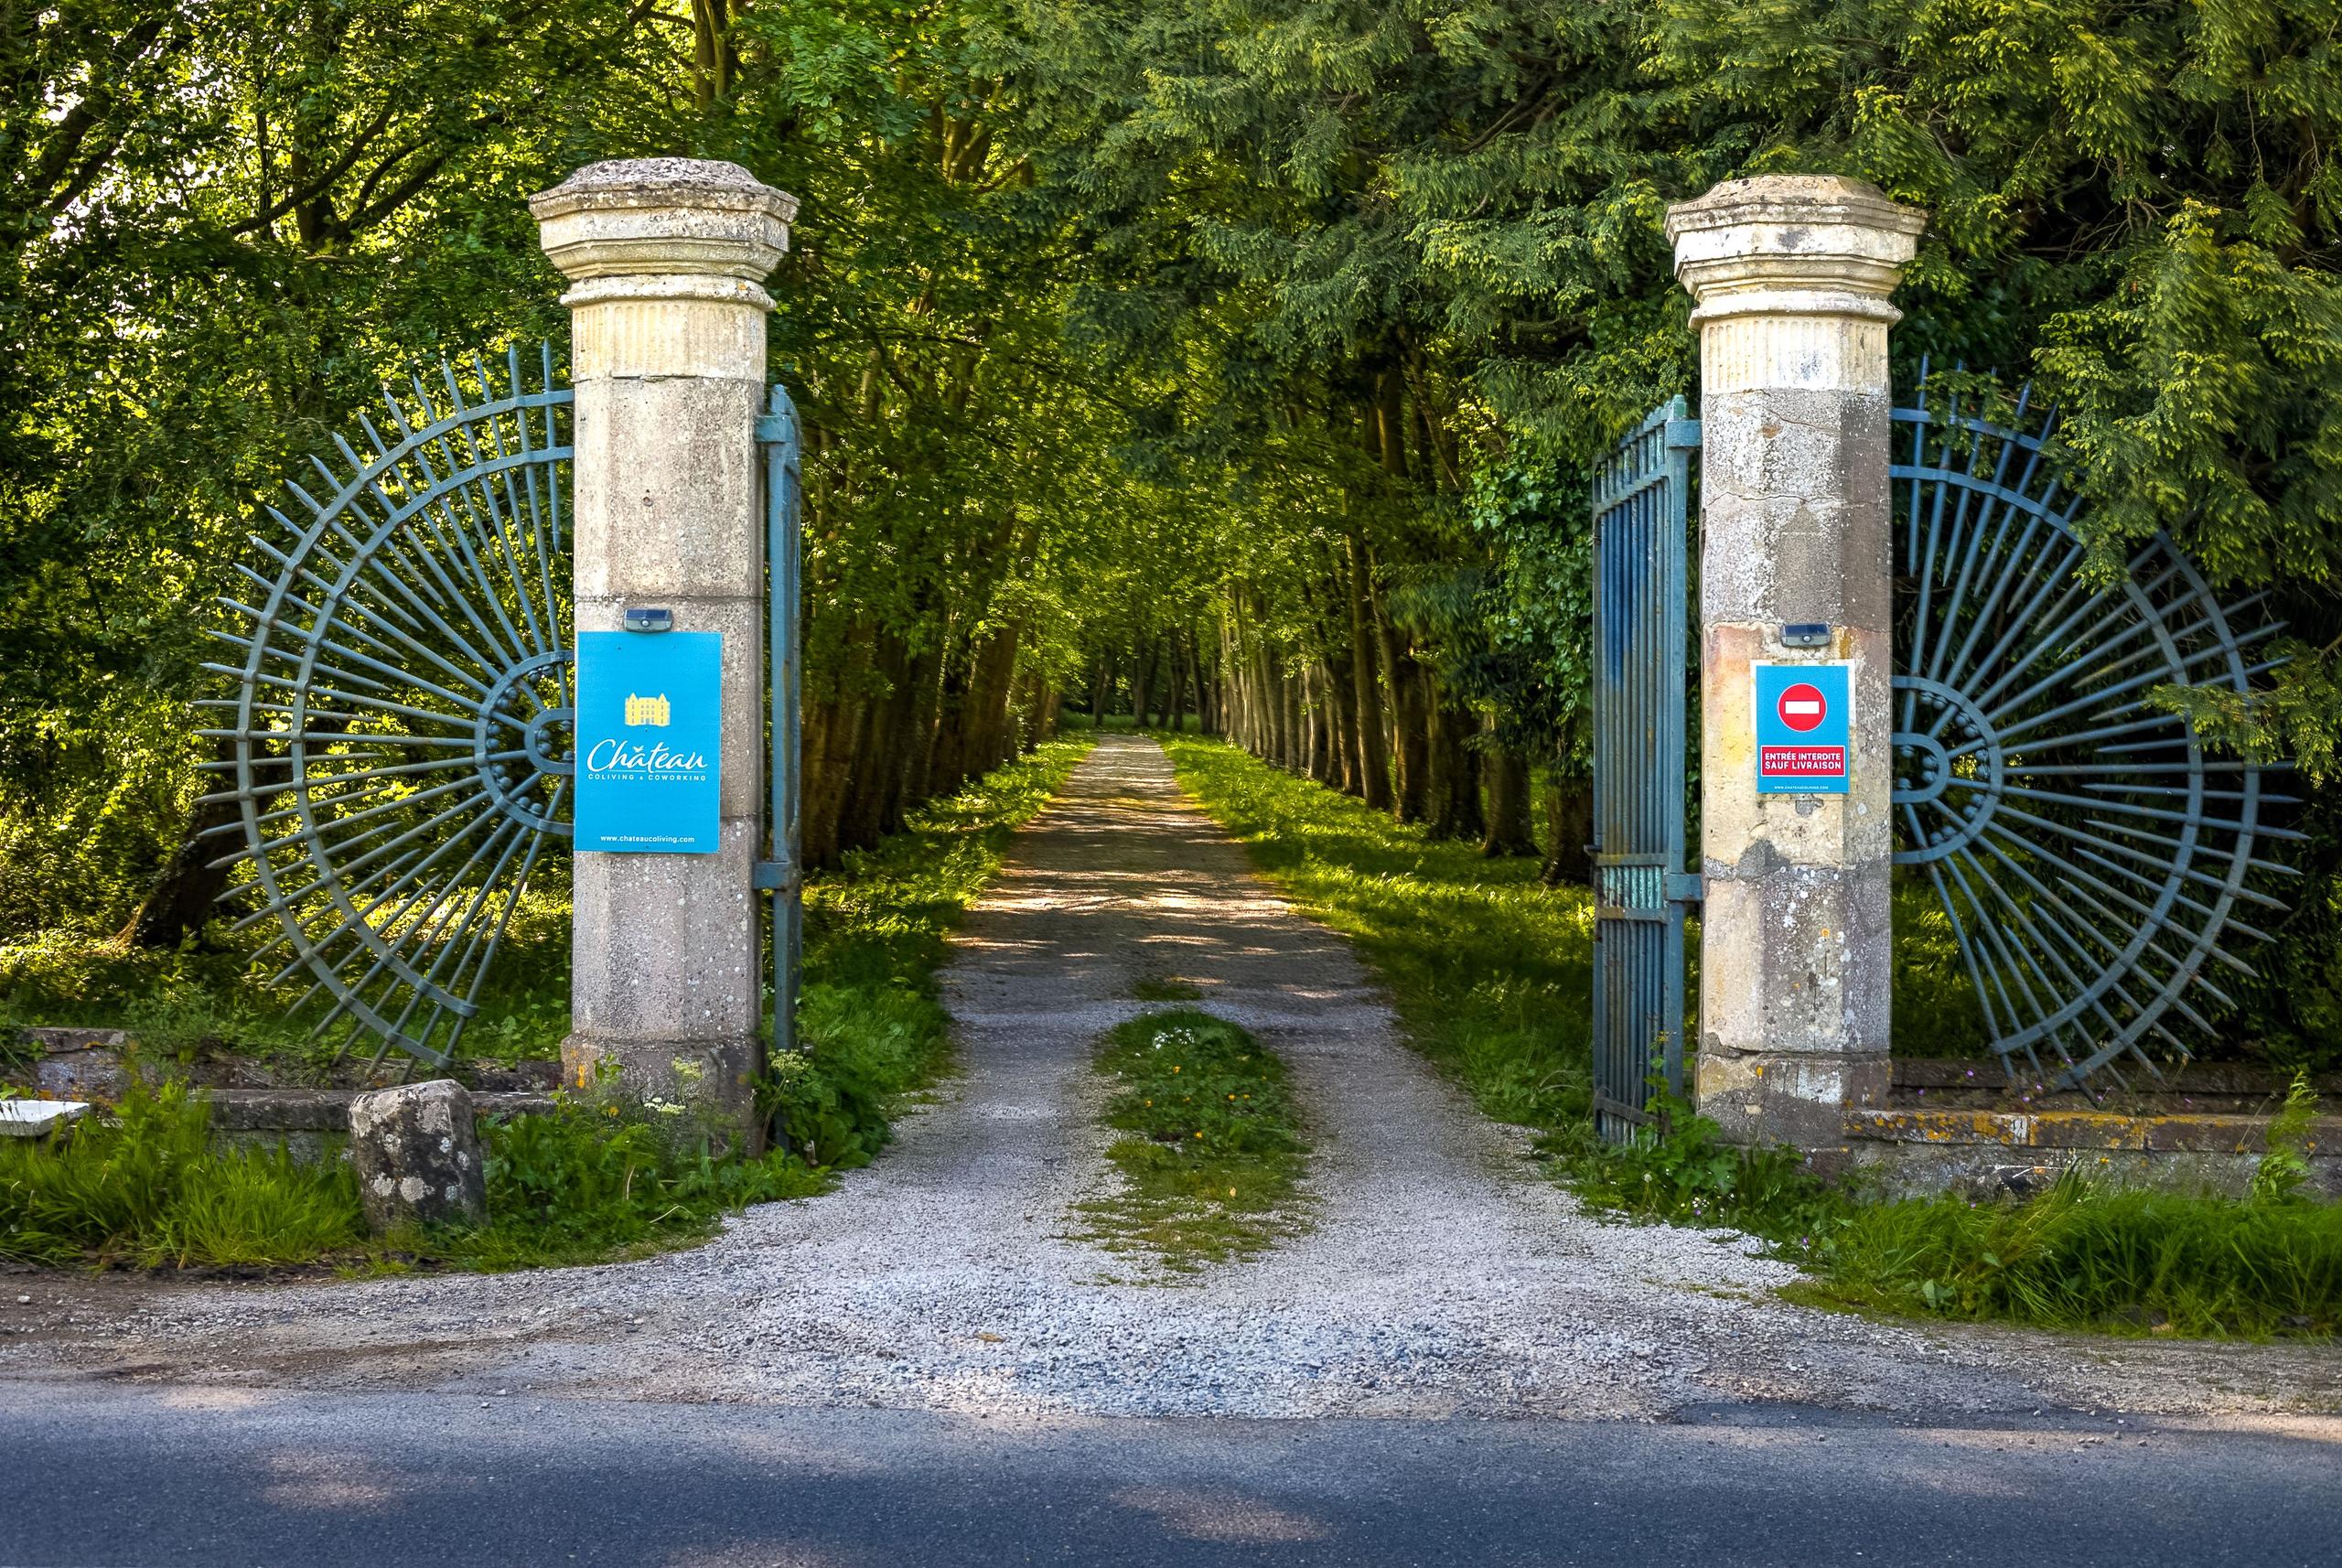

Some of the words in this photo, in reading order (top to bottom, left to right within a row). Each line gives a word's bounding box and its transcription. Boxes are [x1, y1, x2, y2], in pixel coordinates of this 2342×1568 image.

[1765, 751, 1797, 760] ENTRÉE
[1798, 752, 1841, 760] INTERDITE
[1765, 761, 1789, 769] SAUF
[1791, 761, 1842, 769] LIVRAISON
[600, 835, 695, 843] www.chateaucoliving.com
